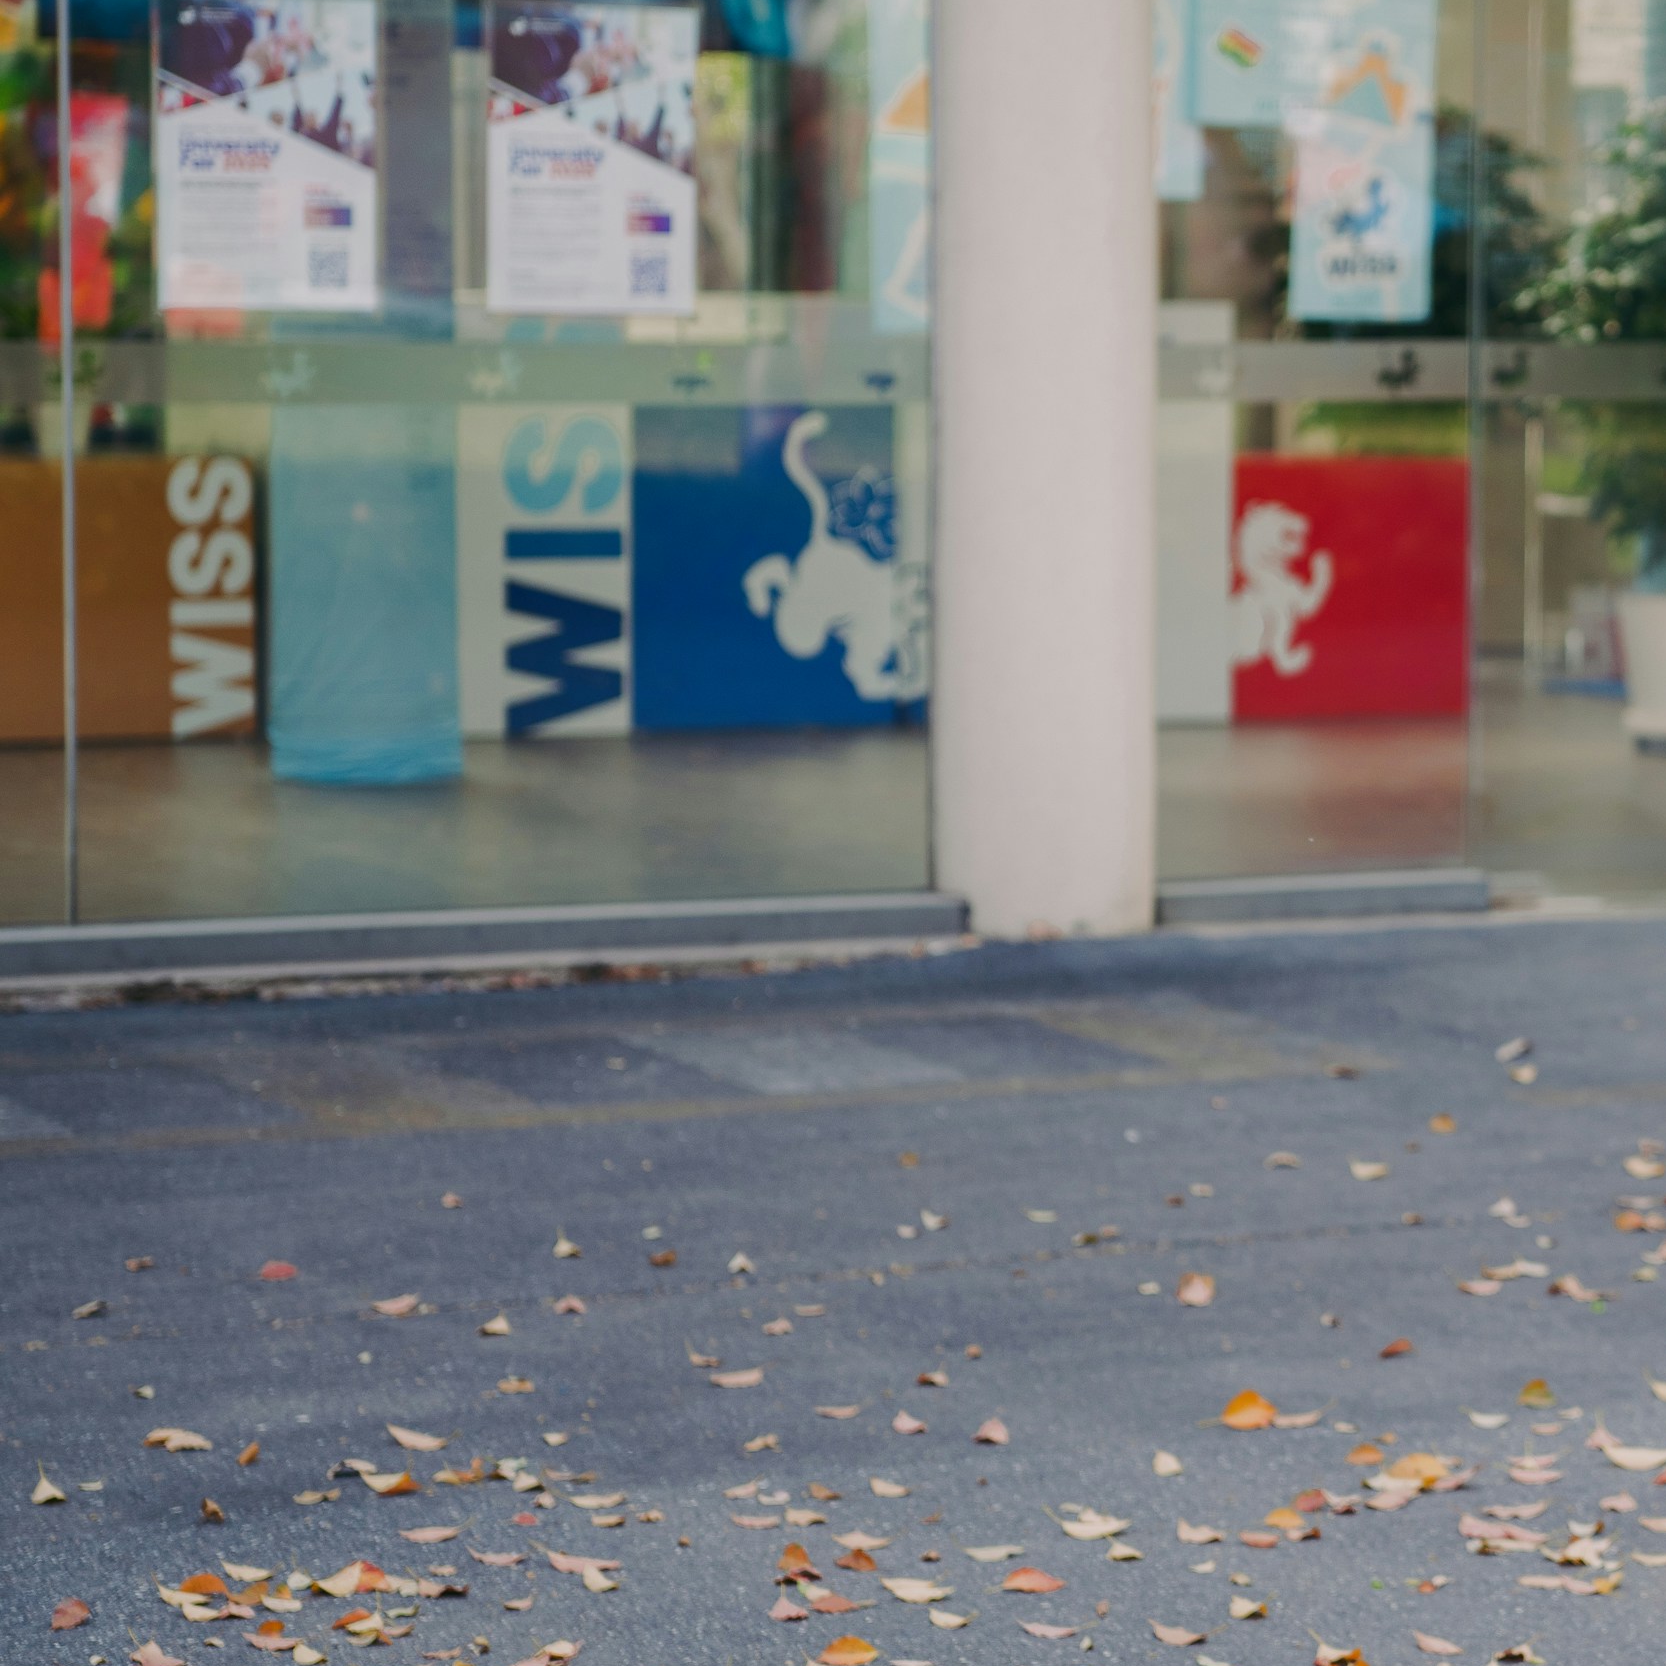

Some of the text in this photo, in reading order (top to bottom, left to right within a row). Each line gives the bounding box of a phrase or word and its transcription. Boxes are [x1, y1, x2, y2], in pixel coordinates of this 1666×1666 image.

[179, 137, 280, 155] University
[510, 145, 604, 162] University
[166, 455, 255, 741] WISS
